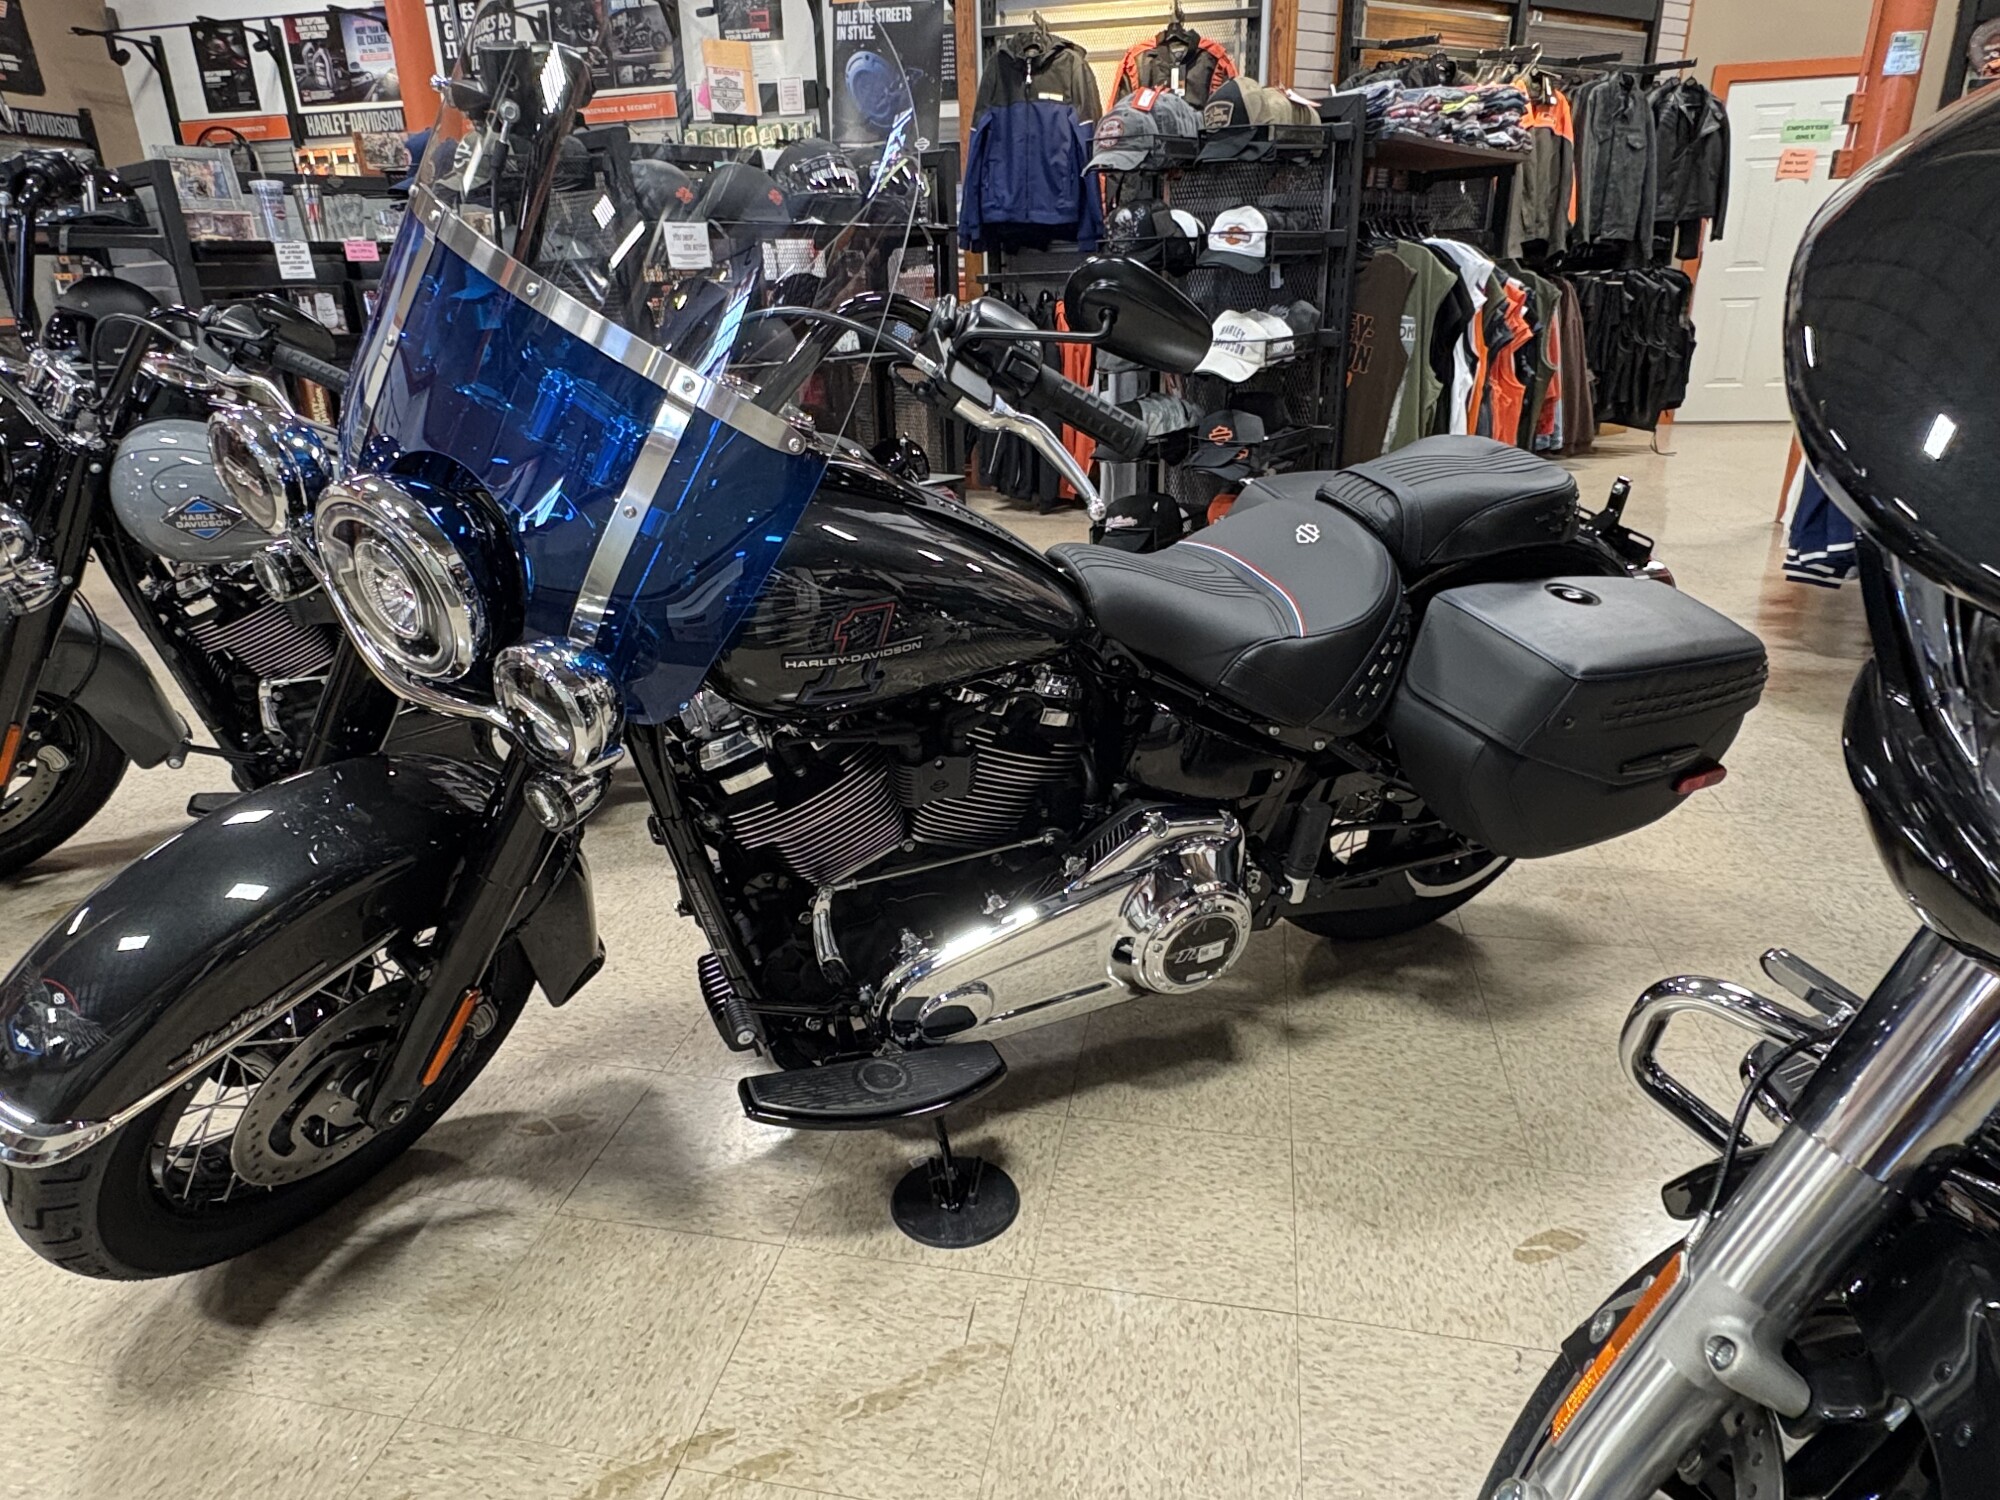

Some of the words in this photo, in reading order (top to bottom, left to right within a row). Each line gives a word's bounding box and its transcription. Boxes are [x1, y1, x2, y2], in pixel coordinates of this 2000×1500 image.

[498, 12, 512, 29] AS
[837, 9, 858, 25] RULE
[859, 9, 875, 24] THE
[875, 6, 912, 22] STREETS
[836, 26, 847, 40] IN
[847, 25, 875, 40] STYLE.
[626, 102, 657, 112] SECURITY
[304, 109, 404, 137] HARLEY-DAVIDSON
[1219, 324, 1246, 341] HARLEY
[1212, 337, 1246, 358] DAVIDSON
[175, 519, 231, 529] DAVIDSON
[179, 512, 227, 521] HARLEY-
[784, 640, 922, 669] HARLEY-DAVIDSON
